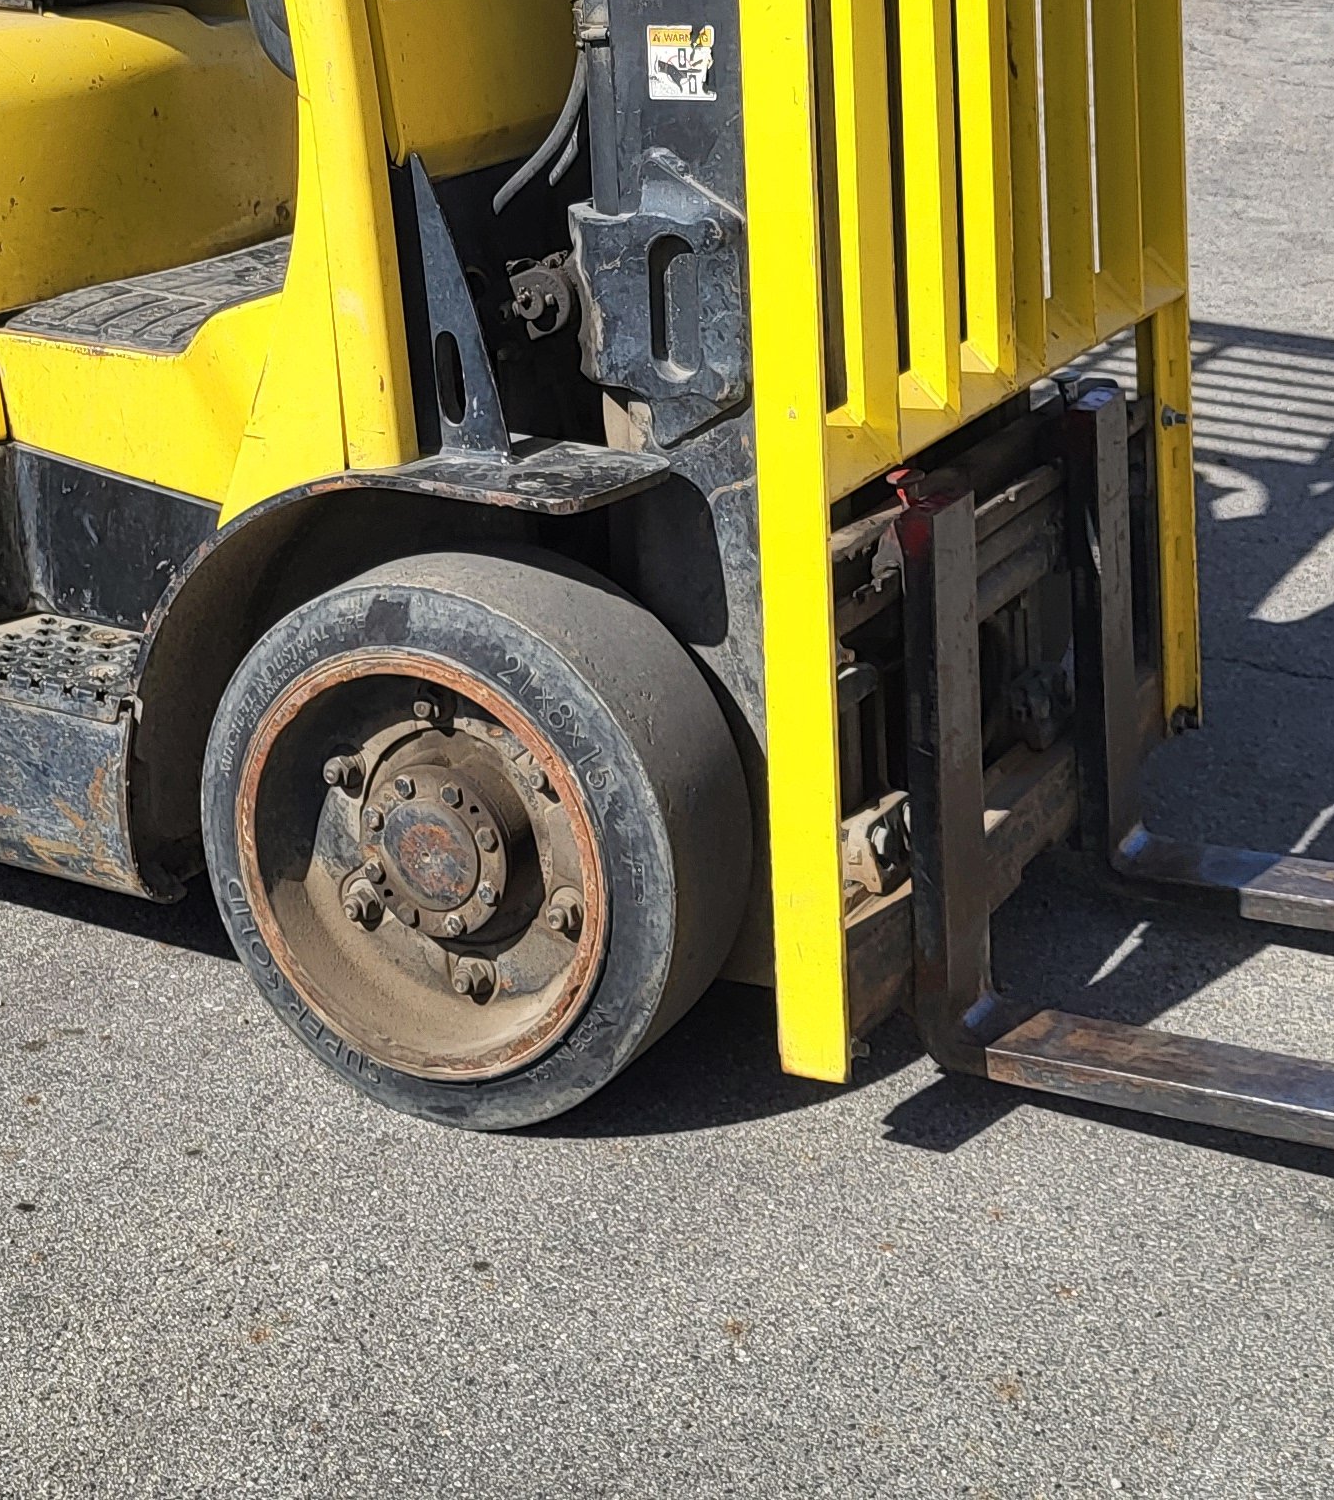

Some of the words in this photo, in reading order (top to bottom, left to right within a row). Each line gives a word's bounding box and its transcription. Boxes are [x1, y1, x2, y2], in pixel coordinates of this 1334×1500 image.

[252, 623, 330, 697] INDUSTRIAL
[228, 878, 286, 991] SOLID
[290, 997, 382, 1085] SUPER
